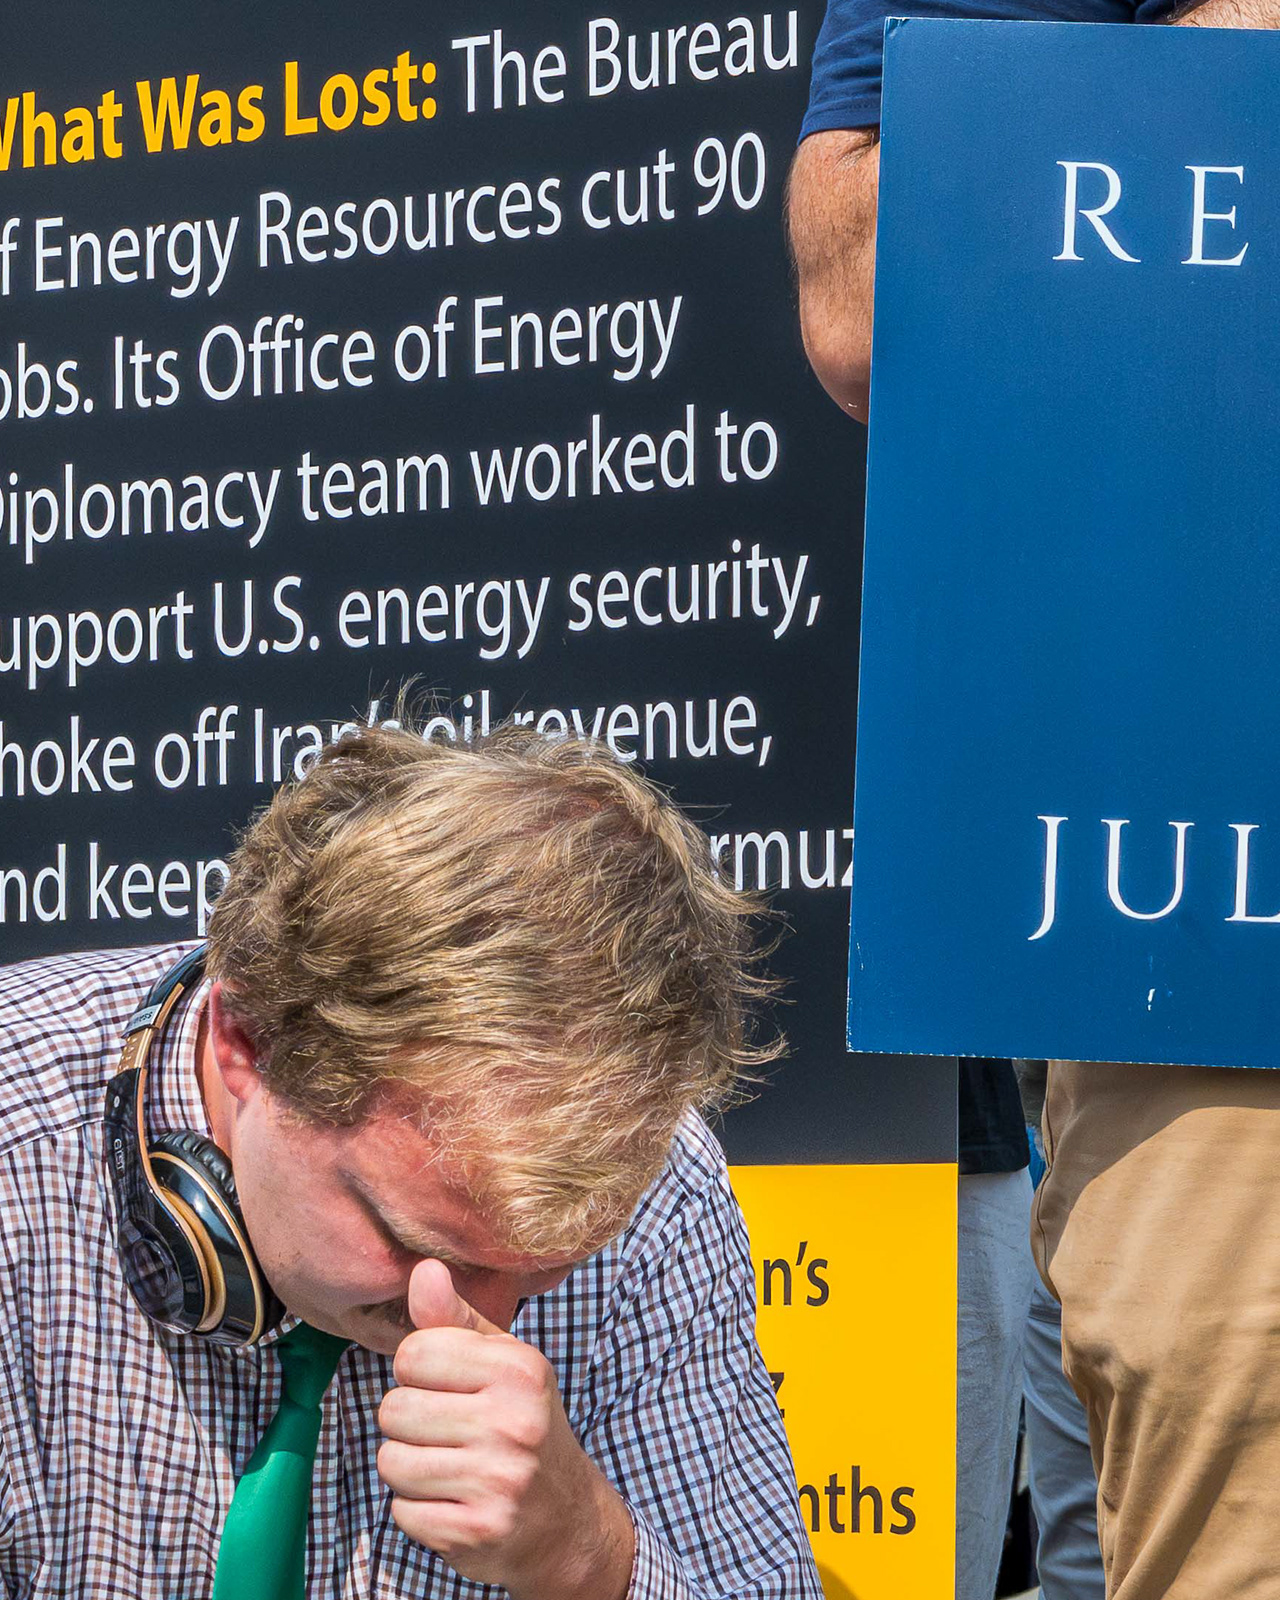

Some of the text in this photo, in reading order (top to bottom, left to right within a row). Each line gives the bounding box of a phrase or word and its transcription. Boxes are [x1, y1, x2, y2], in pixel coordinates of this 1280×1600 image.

[136, 74, 265, 153] Was
[285, 51, 436, 136] Lost:
[452, 29, 566, 112] The
[589, 11, 797, 96] Bureau
[36, 217, 239, 298] Energy
[260, 178, 561, 267] Resources
[582, 149, 675, 229] cut
[694, 132, 765, 215] 90
[115, 336, 179, 409] Its
[199, 314, 375, 400] Office
[395, 296, 457, 381] of
[475, 296, 682, 381] Energy
[297, 452, 449, 521] team
[470, 404, 694, 505] worked
[715, 411, 777, 482] to
[215, 576, 319, 656] U.S.
[339, 577, 550, 659] energy
[568, 539, 820, 639] security,
[155, 705, 238, 788] off
[254, 700, 402, 783] Ira'
[514, 695, 773, 767] evenue,
[90, 842, 231, 937] keep
